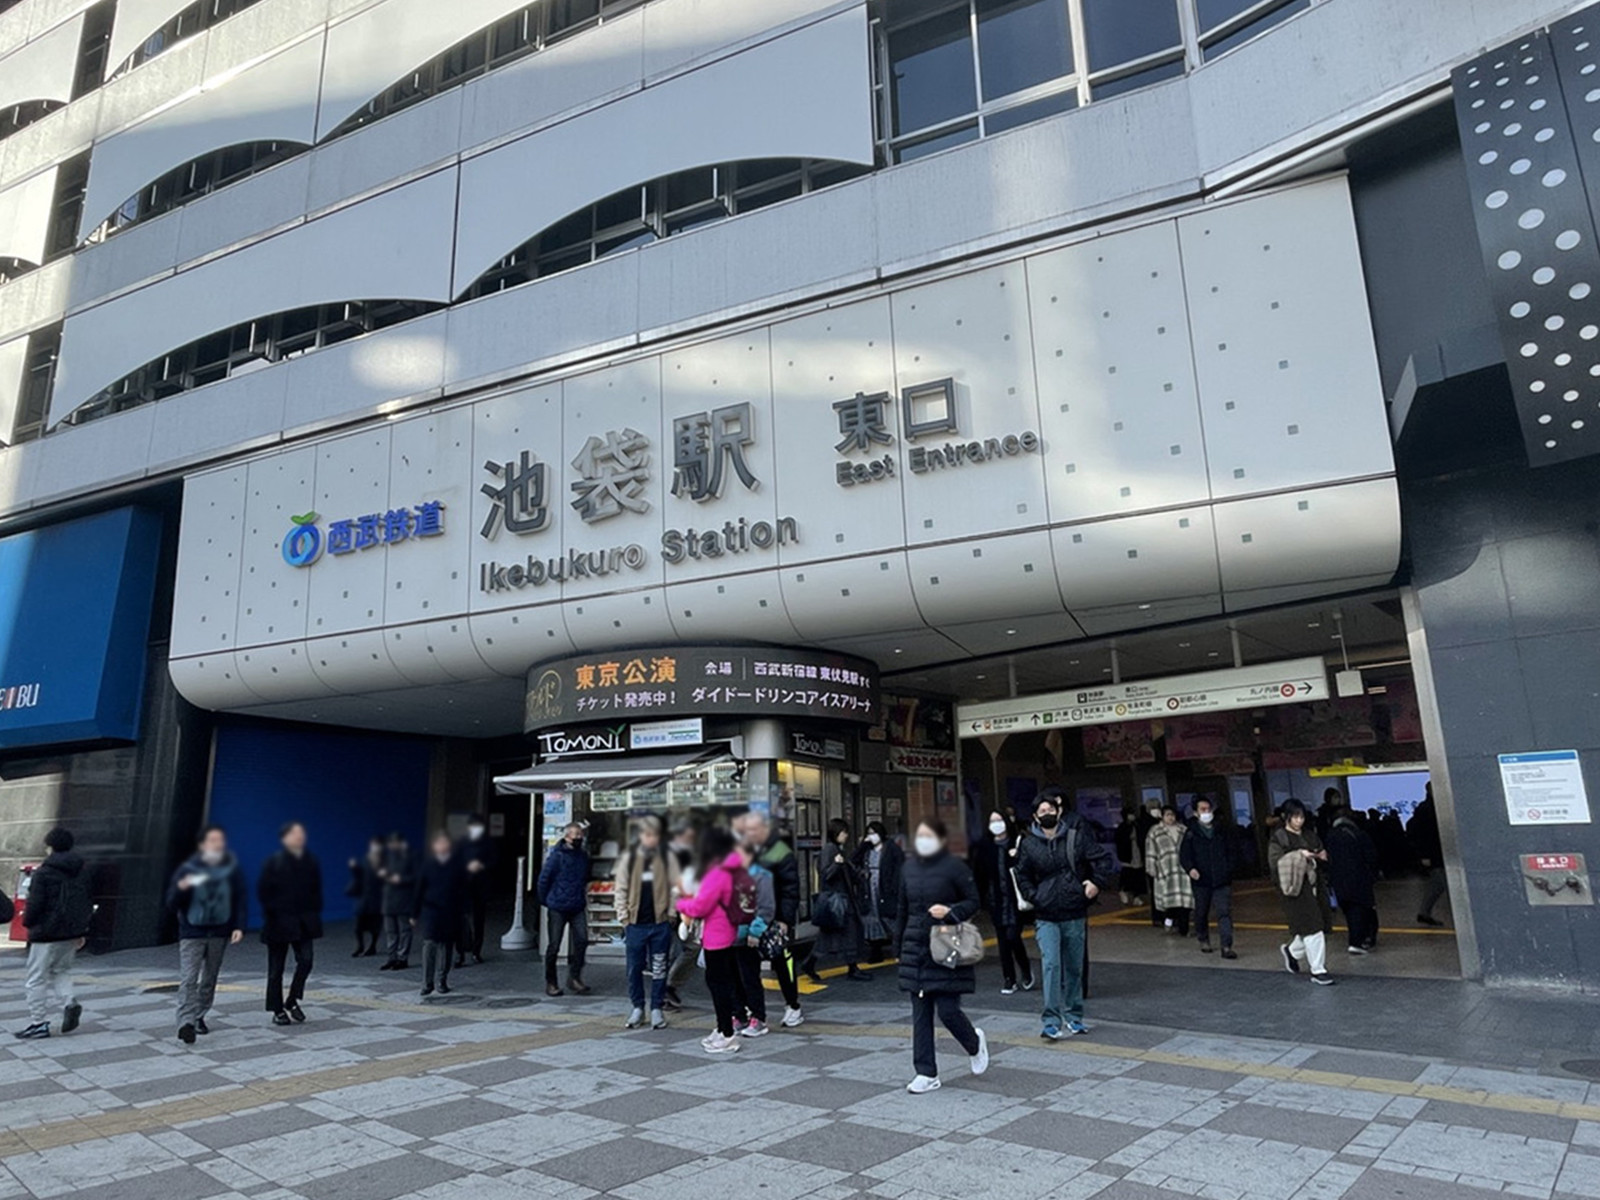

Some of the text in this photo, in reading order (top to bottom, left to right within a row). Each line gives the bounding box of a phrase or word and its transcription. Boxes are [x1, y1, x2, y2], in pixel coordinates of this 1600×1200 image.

[832, 377, 958, 454] 東口
[480, 401, 761, 541] 池袋駅
[836, 431, 1039, 487] East Entrance
[328, 500, 445, 555] 西武鉄道
[480, 515, 799, 592] Ikebukuro Station
[575, 656, 677, 690] 東京公演
[704, 661, 733, 676] 会場
[753, 661, 817, 680] 西武新宿線
[691, 686, 872, 713] ダイドードリンコアイスアリーナ
[538, 724, 626, 757] TOMONY
